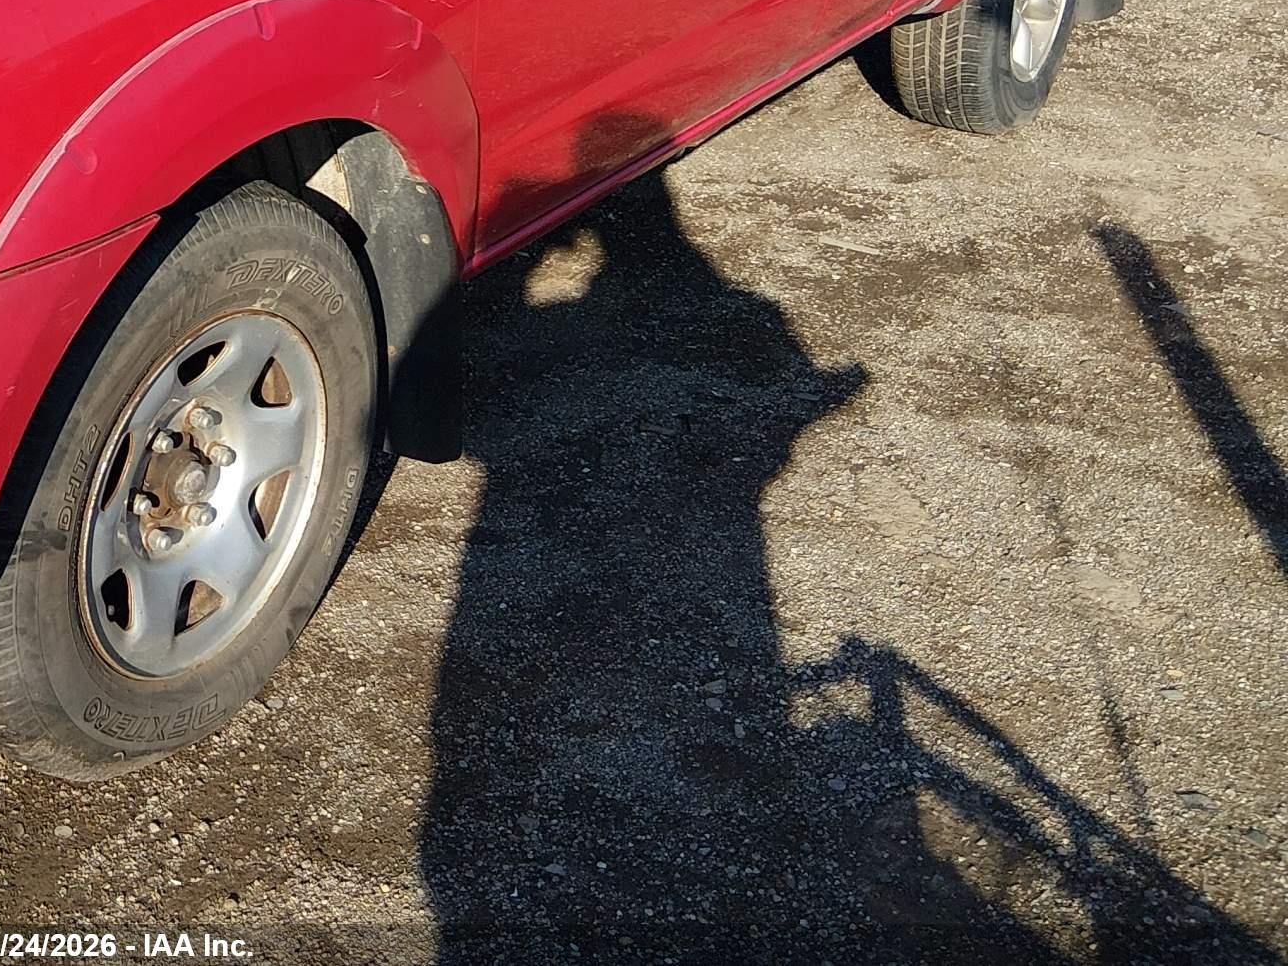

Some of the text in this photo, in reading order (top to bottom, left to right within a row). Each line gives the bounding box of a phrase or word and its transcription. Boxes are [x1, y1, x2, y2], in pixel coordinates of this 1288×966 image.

[225, 257, 345, 316] DEXTERO
[57, 423, 101, 532] DHT2
[83, 692, 227, 743] DEXTERO
